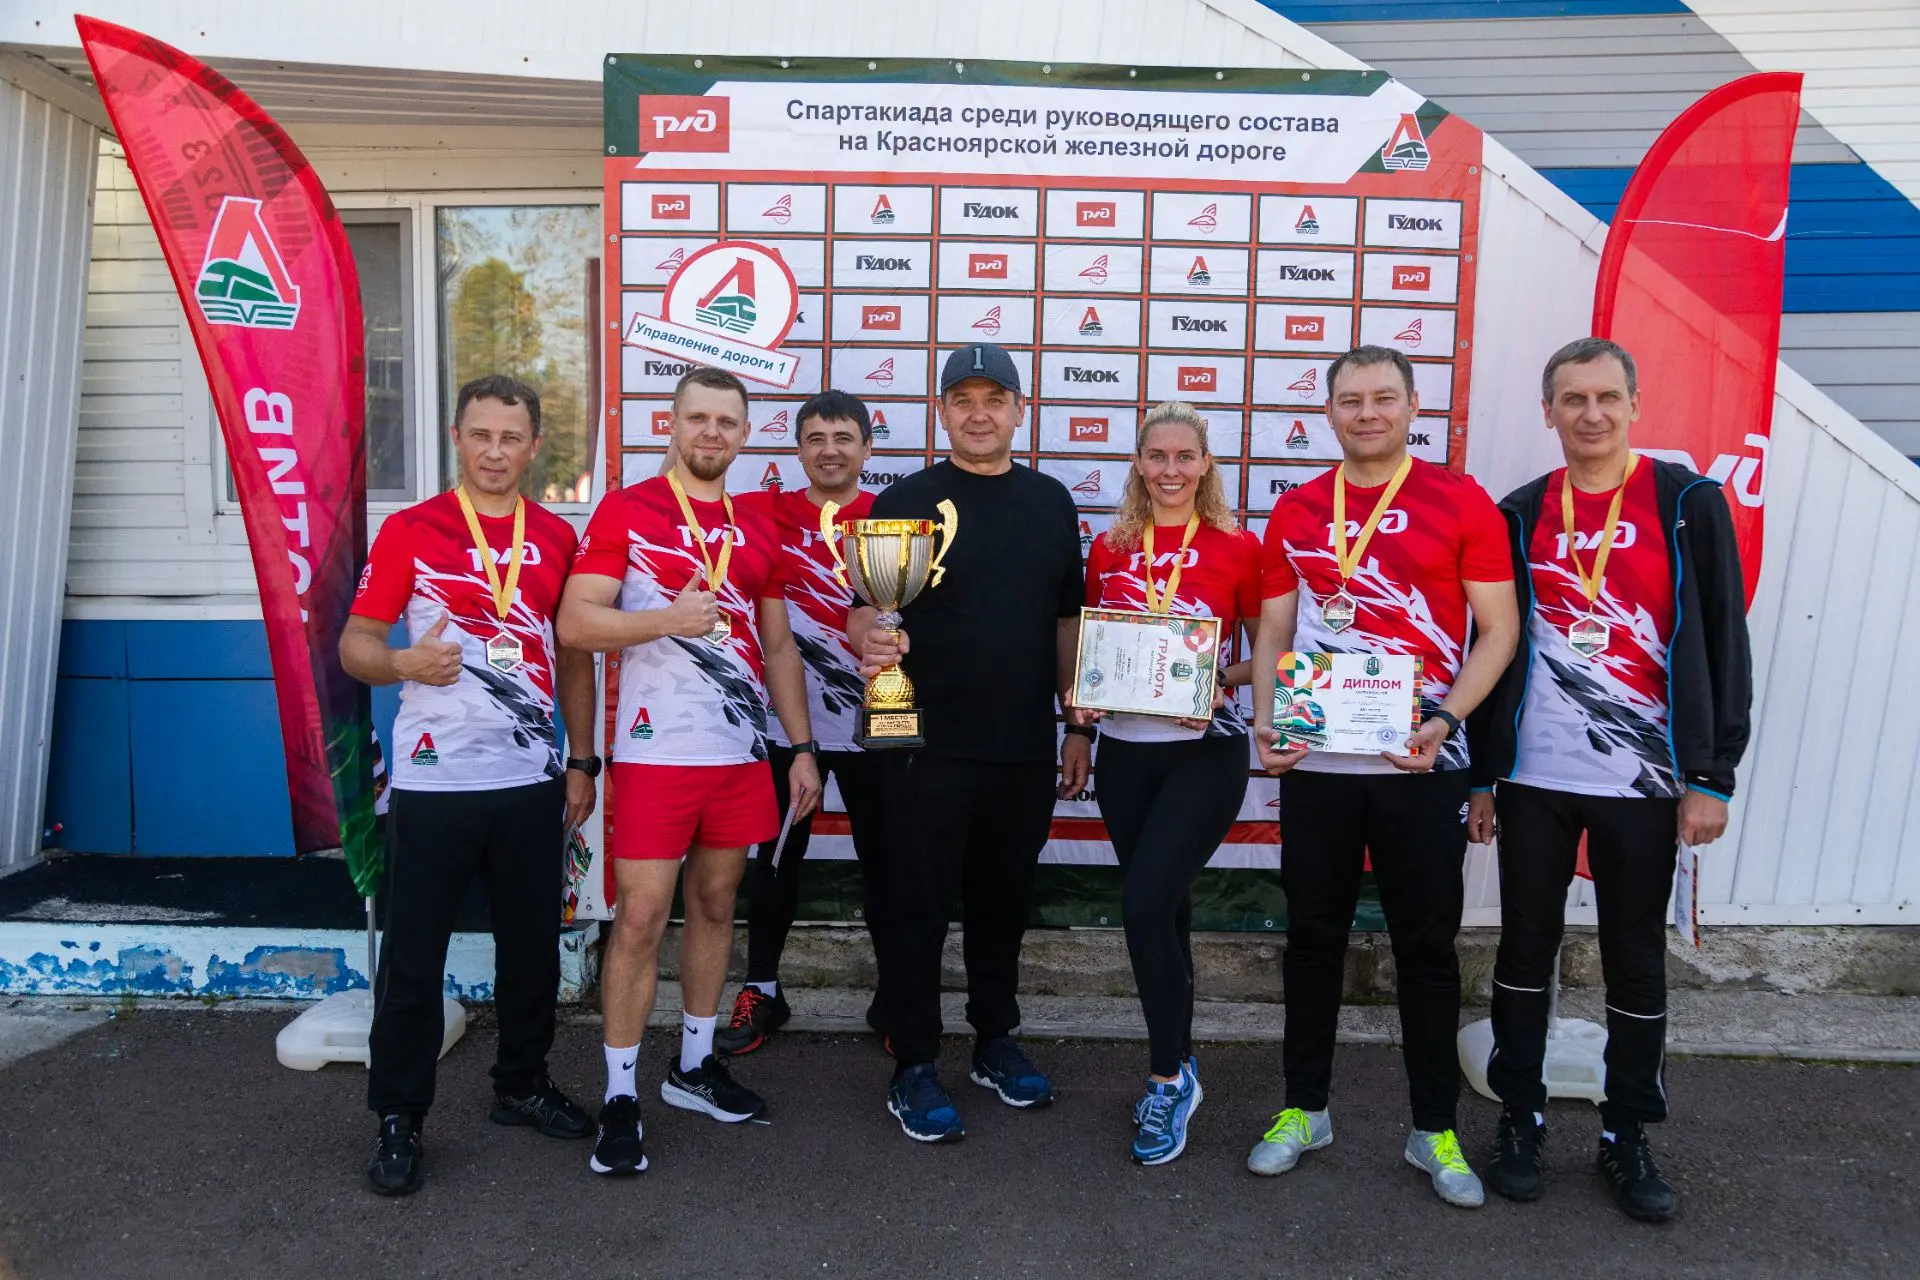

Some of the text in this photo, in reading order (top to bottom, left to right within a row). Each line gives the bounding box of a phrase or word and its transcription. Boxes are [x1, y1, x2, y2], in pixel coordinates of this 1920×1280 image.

[786, 99, 1339, 133] Спартакиада среди руководящего состава
[839, 129, 1287, 164] на Красноярской железной дороге
[635, 322, 786, 374] Управление дороги 1
[1153, 638, 1168, 698] ГРАМОТА
[1342, 678, 1402, 690] ДИПЛОМ
